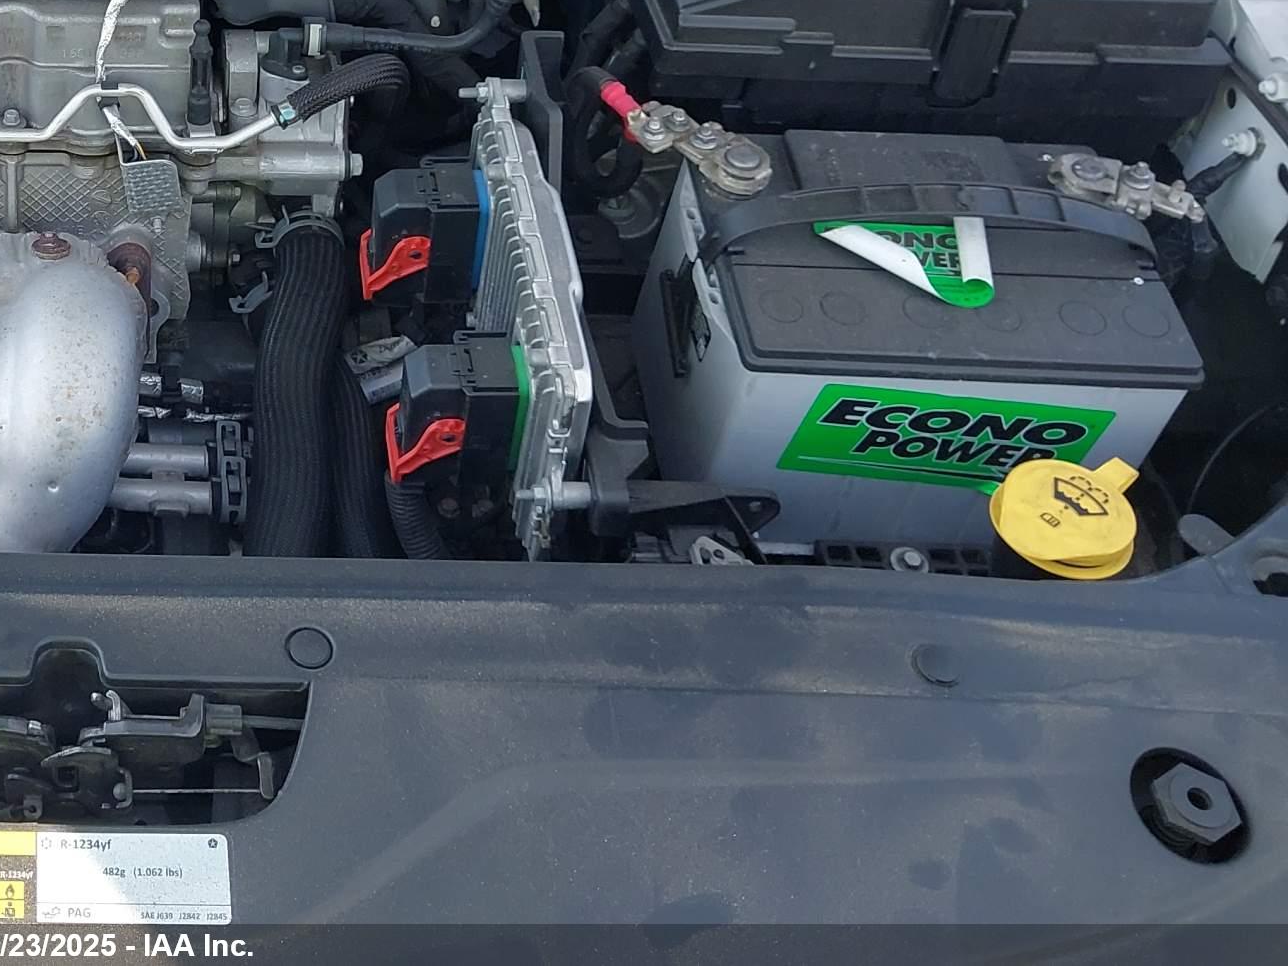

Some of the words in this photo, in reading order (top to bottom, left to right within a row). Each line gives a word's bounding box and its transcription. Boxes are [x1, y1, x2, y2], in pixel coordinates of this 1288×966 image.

[817, 397, 1088, 446] ECONO
[60, 838, 112, 851] R-1234yf
[102, 867, 126, 878] 482g
[133, 867, 163, 878] (1.062
[165, 867, 183, 878] lbs)
[67, 907, 91, 918] PAG
